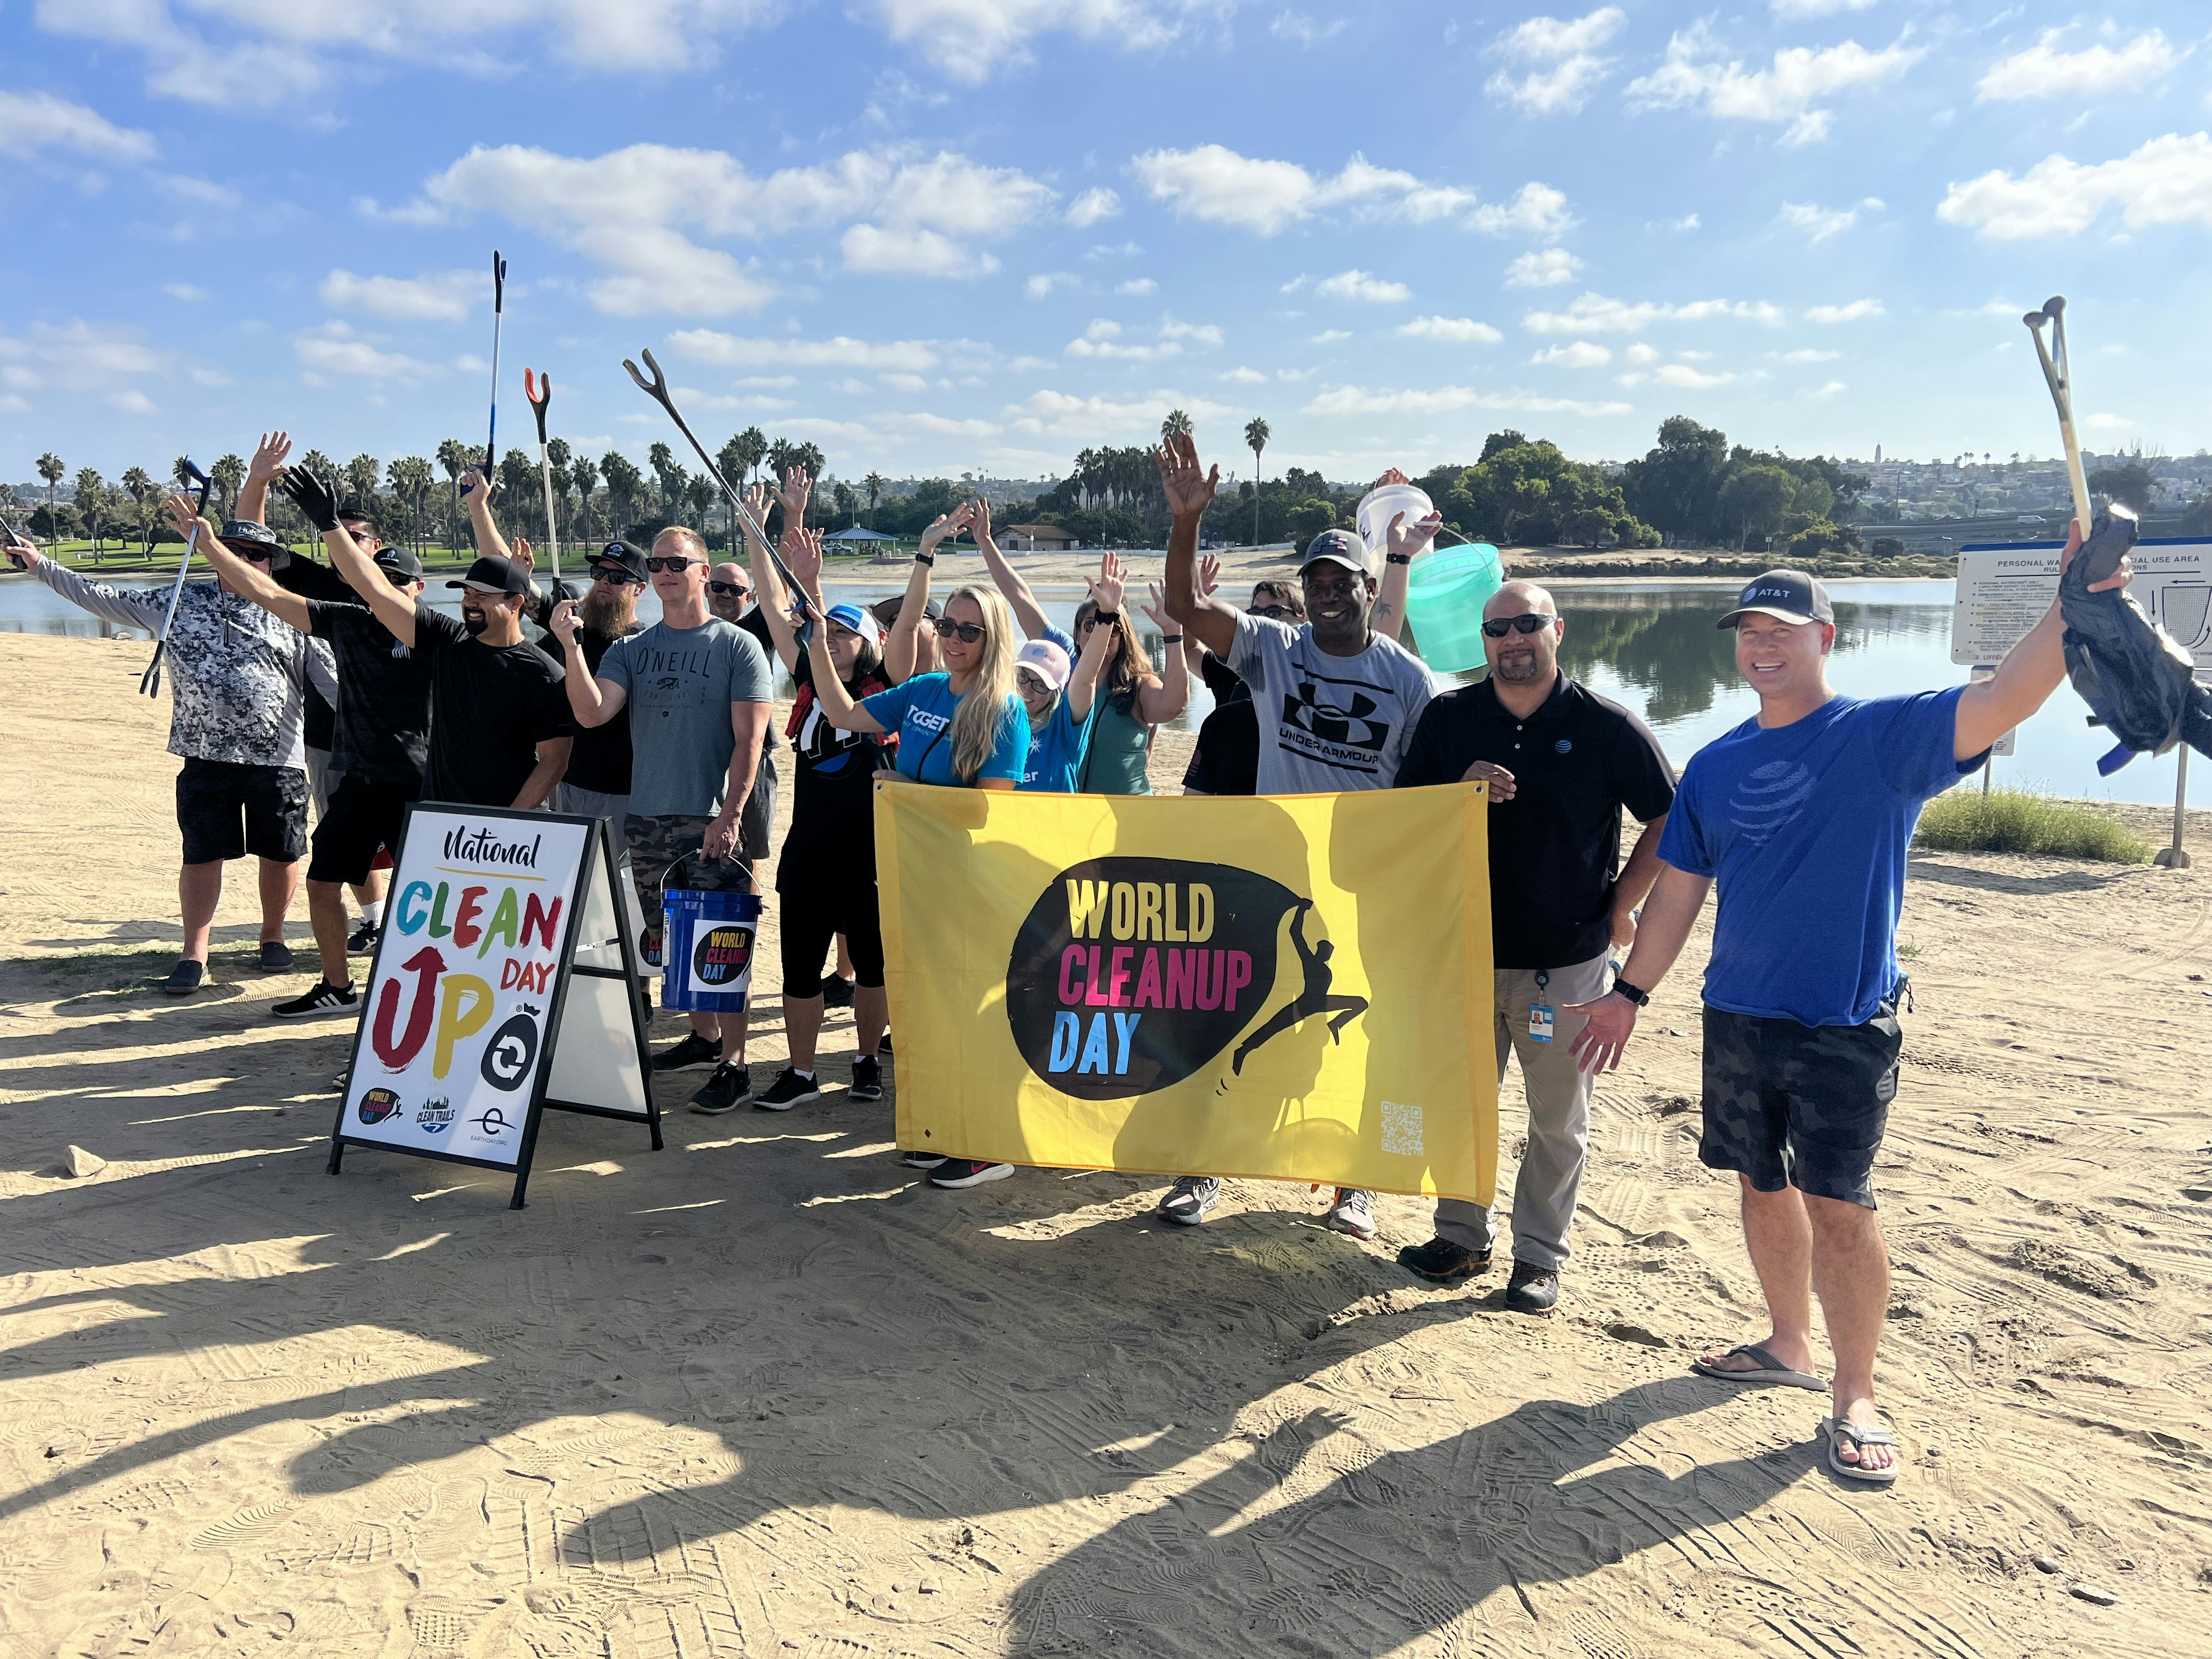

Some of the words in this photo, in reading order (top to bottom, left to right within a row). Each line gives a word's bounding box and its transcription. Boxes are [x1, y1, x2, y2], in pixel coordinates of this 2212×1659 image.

[1757, 588, 1791, 598] AT&T
[636, 647, 711, 679] O'NEILL
[1279, 727, 1321, 751] UNDER
[1322, 746, 1379, 764] ARMOUR
[443, 825, 541, 868] National
[396, 879, 565, 960] CLEAN
[1065, 878, 1215, 943] WORLD
[710, 931, 746, 948] WORLD
[706, 947, 751, 964] CLEANUP
[500, 957, 556, 995] DAY
[702, 963, 727, 980] DAY
[1058, 944, 1252, 1012] CLEANUP
[372, 946, 495, 1082] UP
[1048, 1011, 1142, 1075] DAY
[365, 1101, 392, 1114] CLEANUP
[369, 1091, 390, 1103] WORLD
[362, 1110, 375, 1121] DAY
[416, 1111, 435, 1123] CLEAN
[434, 1109, 455, 1122] TRAILS
[470, 1135, 508, 1146] EARTHDAY.ORG
